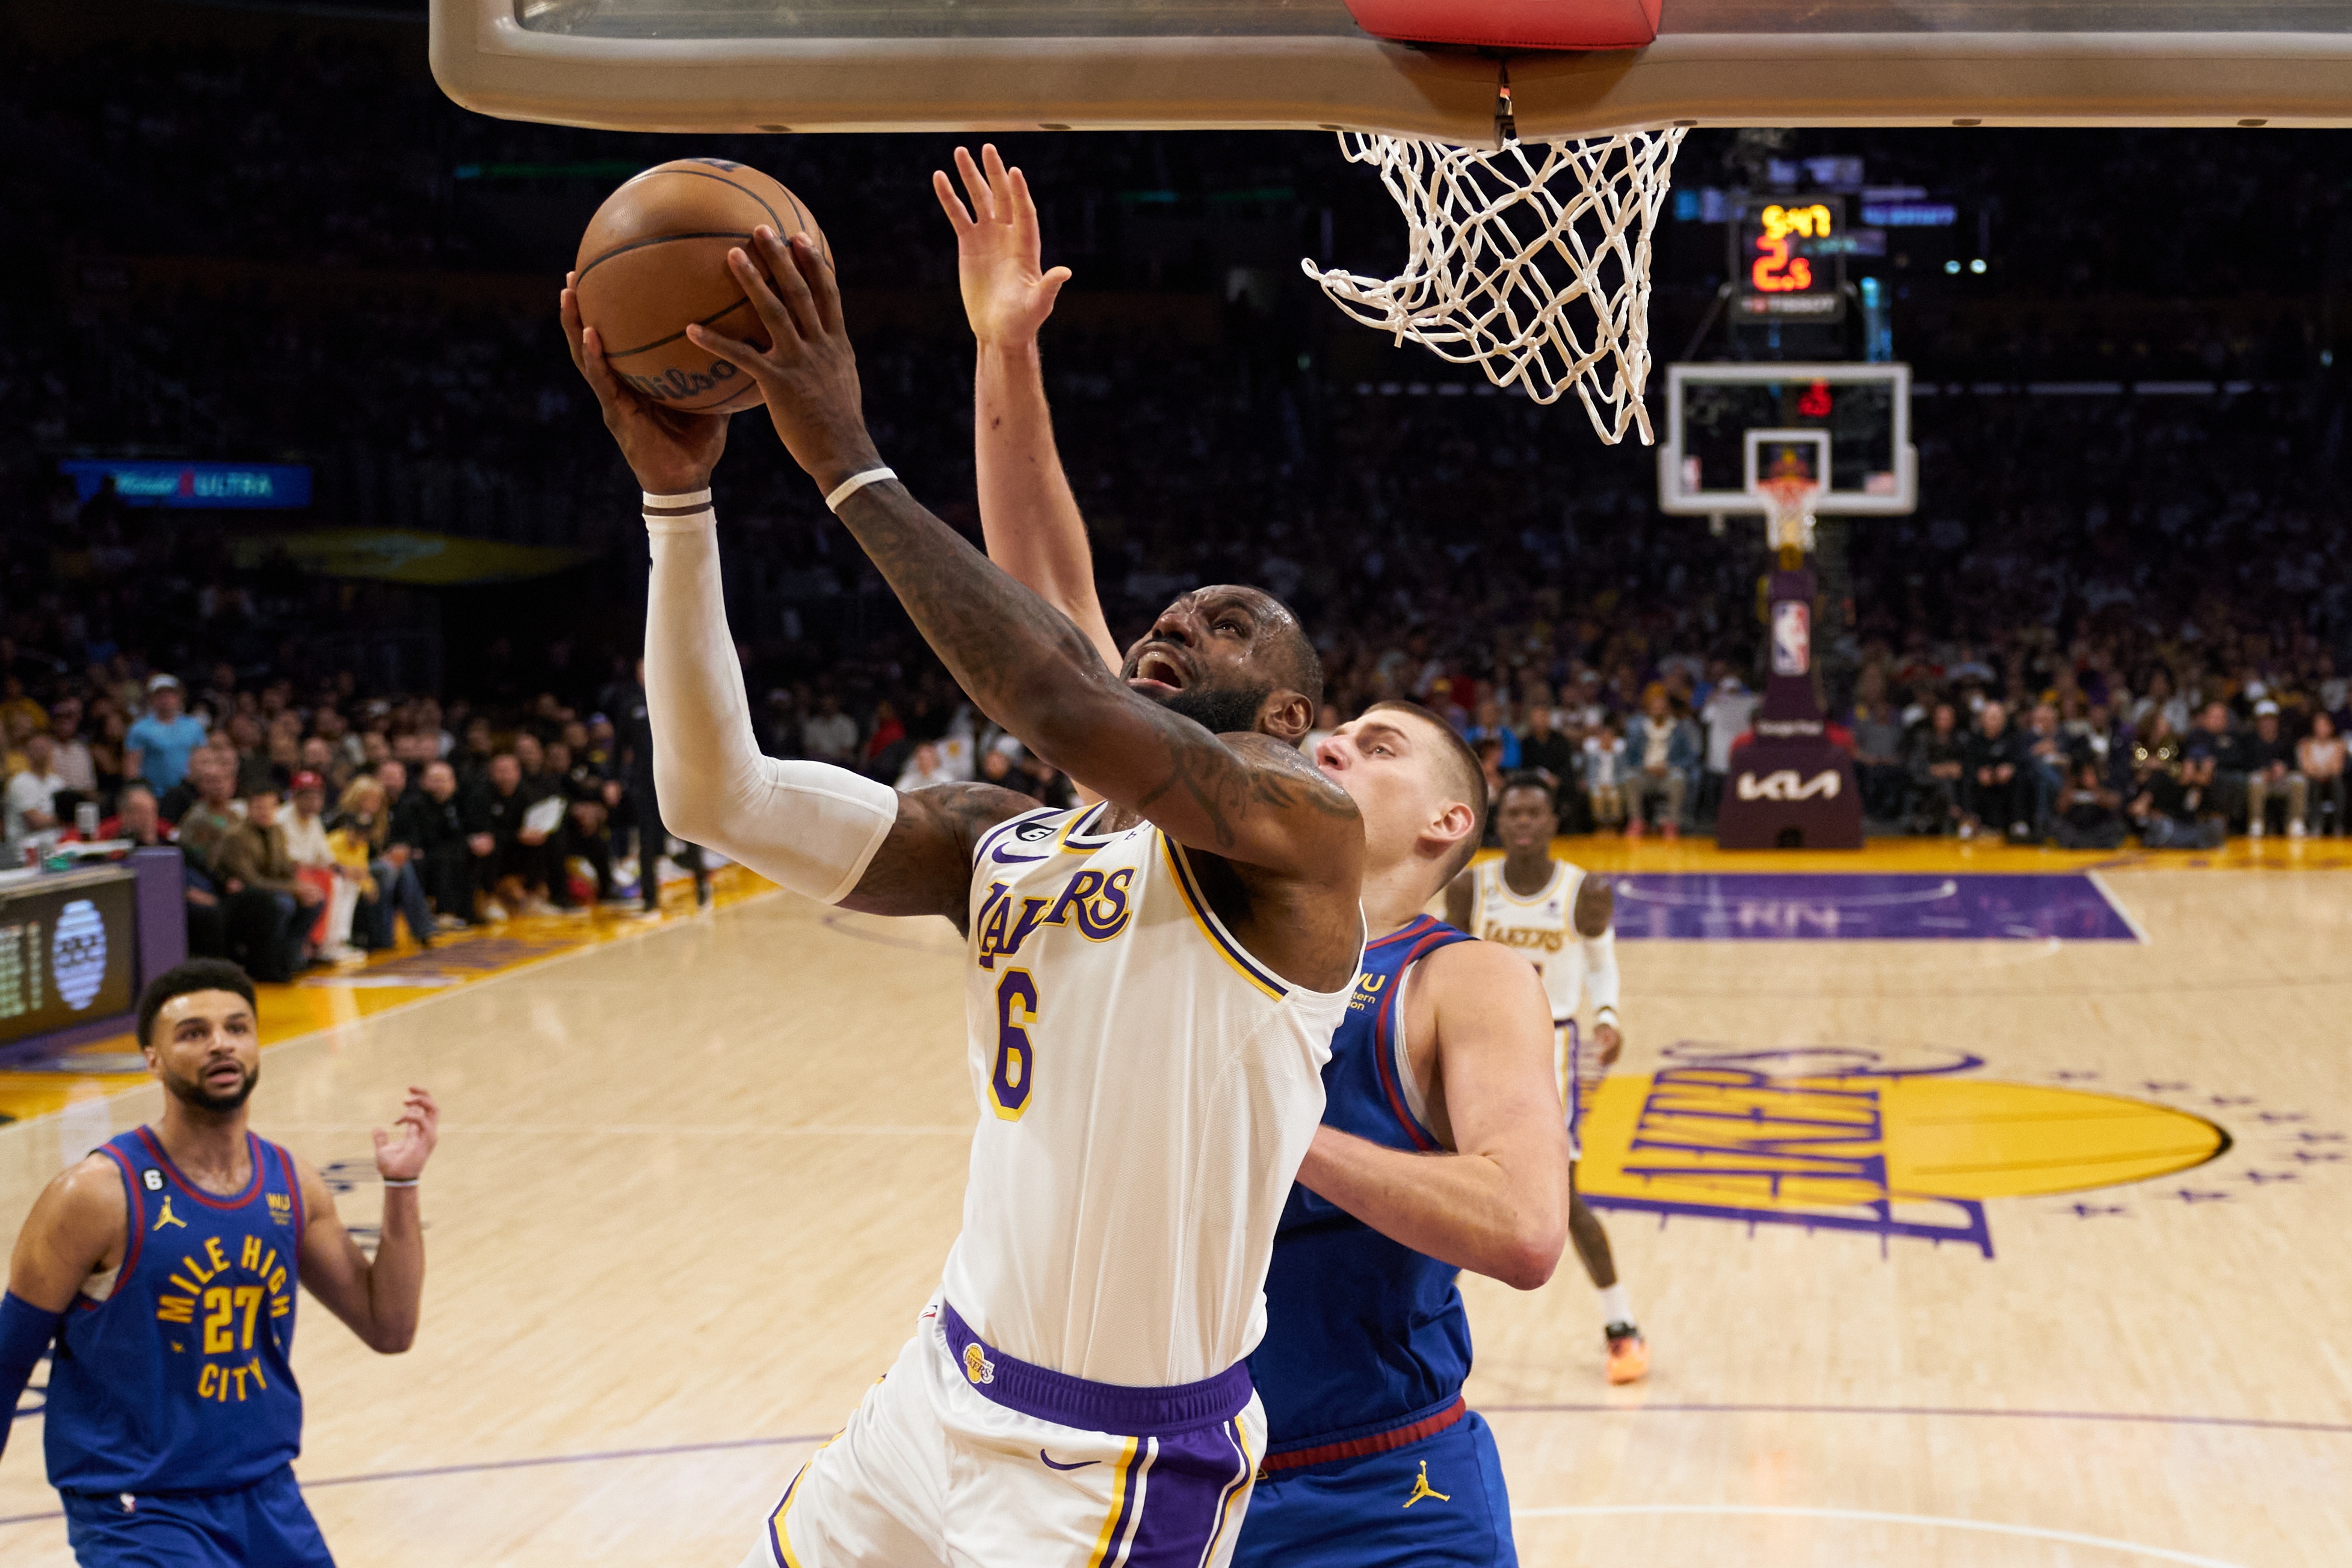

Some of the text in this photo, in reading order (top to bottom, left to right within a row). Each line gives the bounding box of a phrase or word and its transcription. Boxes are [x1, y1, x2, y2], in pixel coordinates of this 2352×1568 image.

[1021, 824, 1047, 841] 6
[1353, 992, 1375, 1004] tern
[987, 966, 1040, 1123] 6
[144, 1170, 163, 1190] 6
[156, 1234, 290, 1324] MILE HIGH
[203, 1285, 266, 1354] 27
[197, 1356, 267, 1403] CITY
